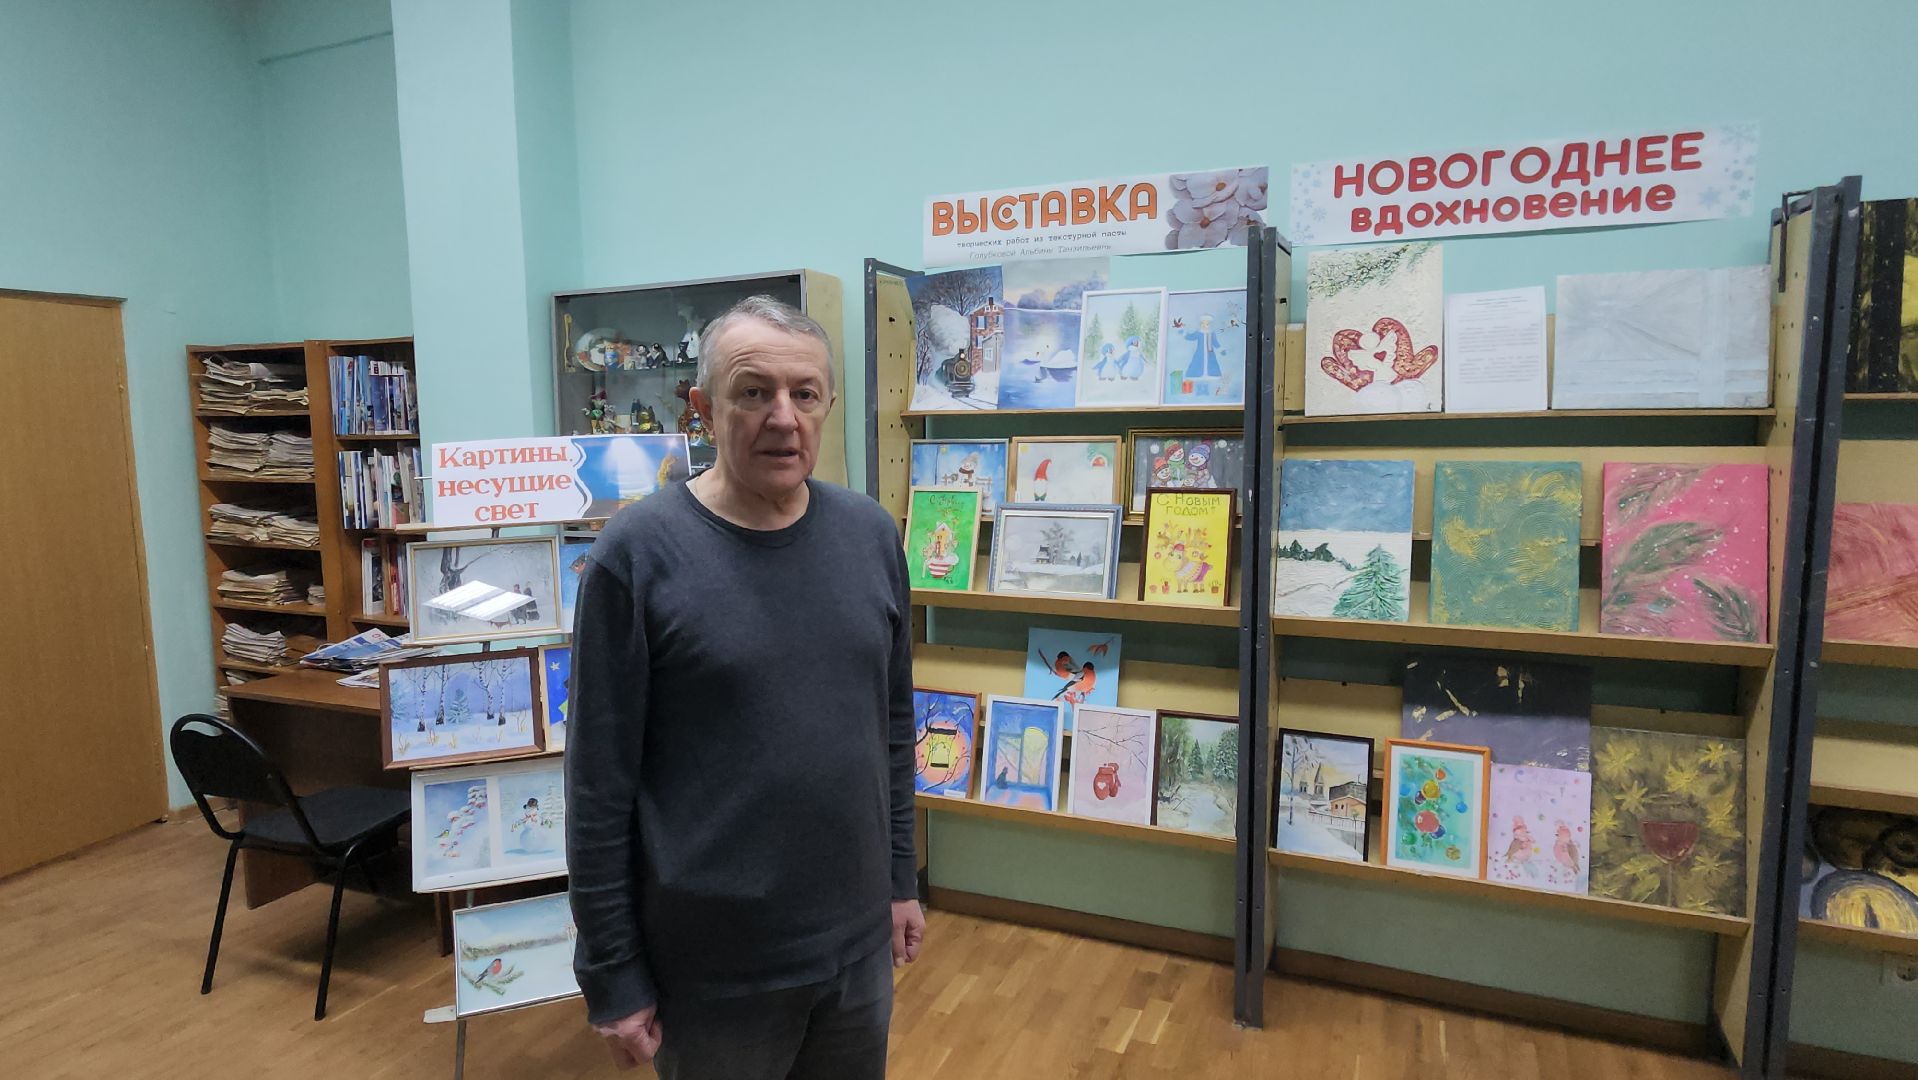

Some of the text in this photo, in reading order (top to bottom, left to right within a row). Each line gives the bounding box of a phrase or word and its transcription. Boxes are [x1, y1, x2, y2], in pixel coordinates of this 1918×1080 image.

[1333, 131, 1705, 198] НОВОГОДНЕЕ
[932, 182, 1158, 236] ВЫСТАВКА
[1350, 183, 1677, 236] вдохновение
[956, 238, 1002, 249] творческих
[1005, 236, 1030, 247] работ
[1048, 231, 1097, 243] текстурной
[1101, 229, 1127, 238] пасты
[437, 474, 572, 497] несущие
[474, 502, 540, 522] свет
